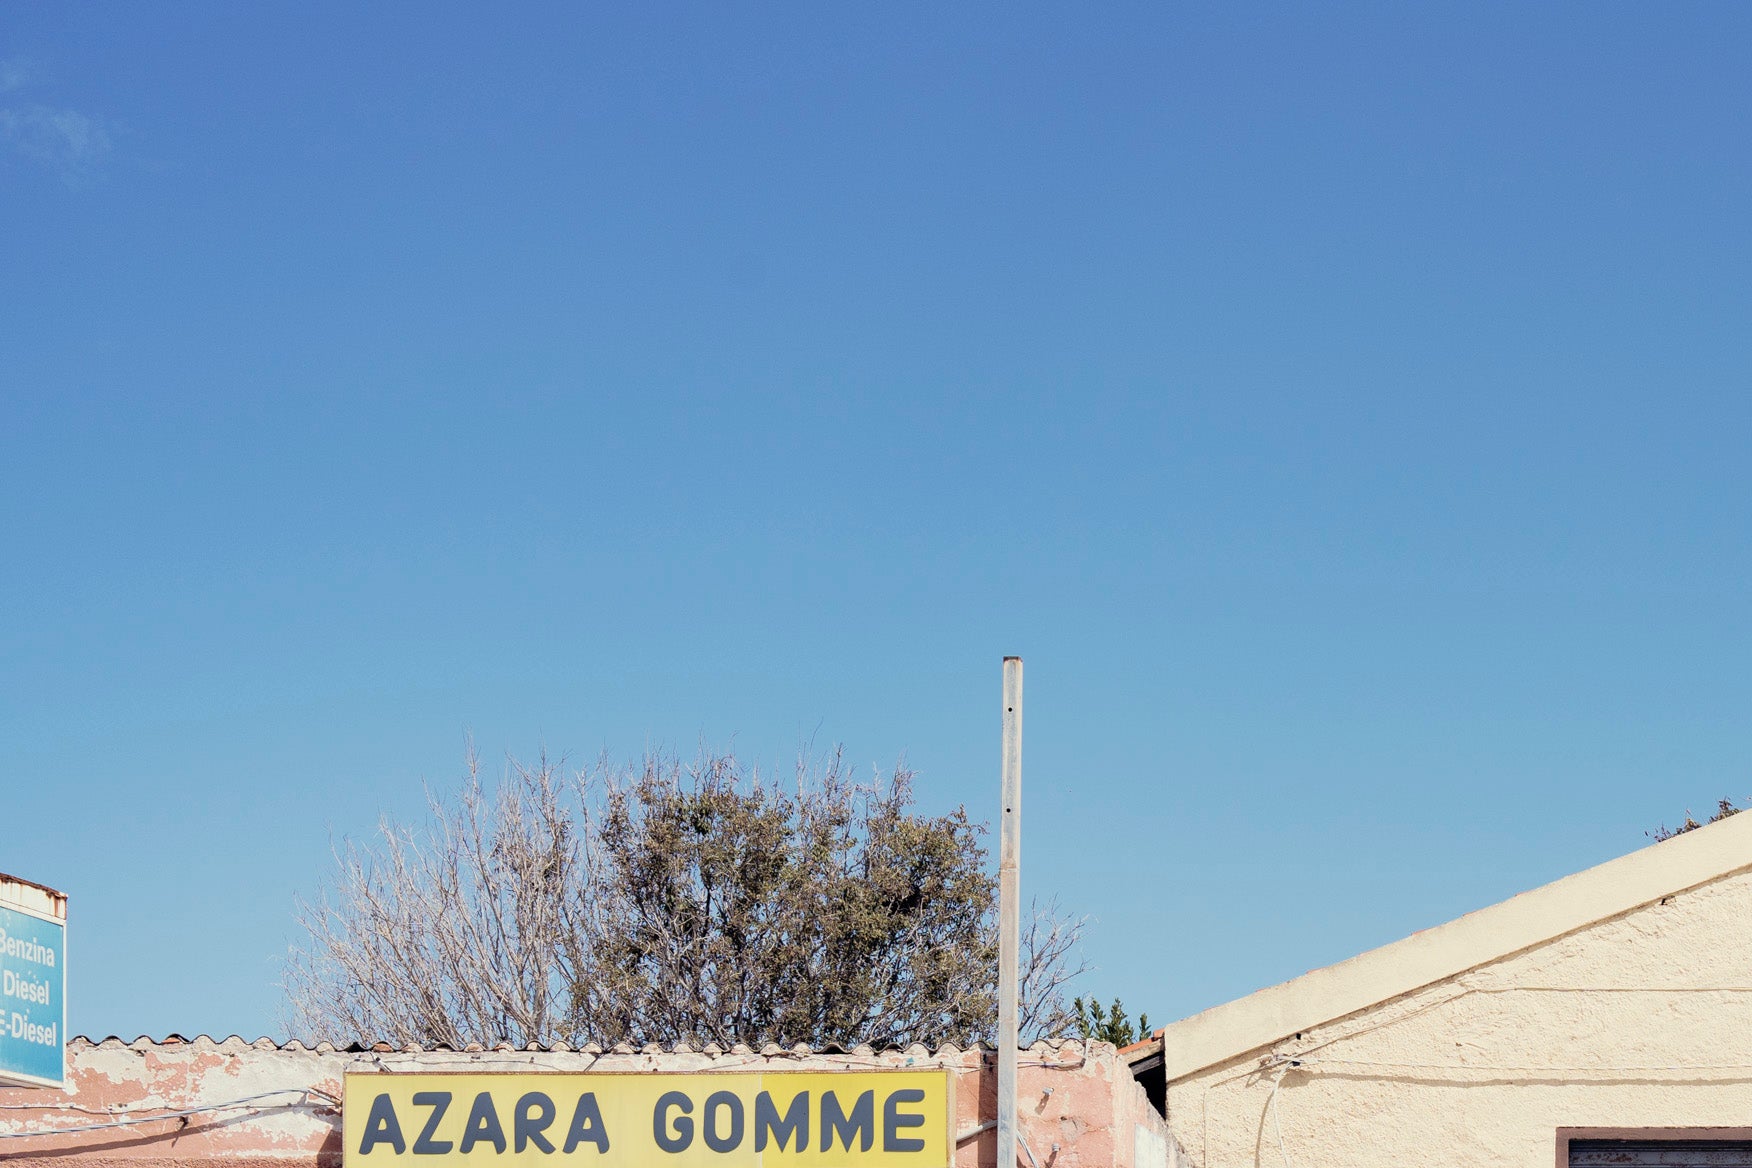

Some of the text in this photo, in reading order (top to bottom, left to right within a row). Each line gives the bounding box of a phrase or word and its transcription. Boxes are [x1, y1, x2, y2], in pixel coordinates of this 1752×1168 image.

[3, 970, 49, 1005] Diesel
[358, 1089, 926, 1155] AZARA GOMME
